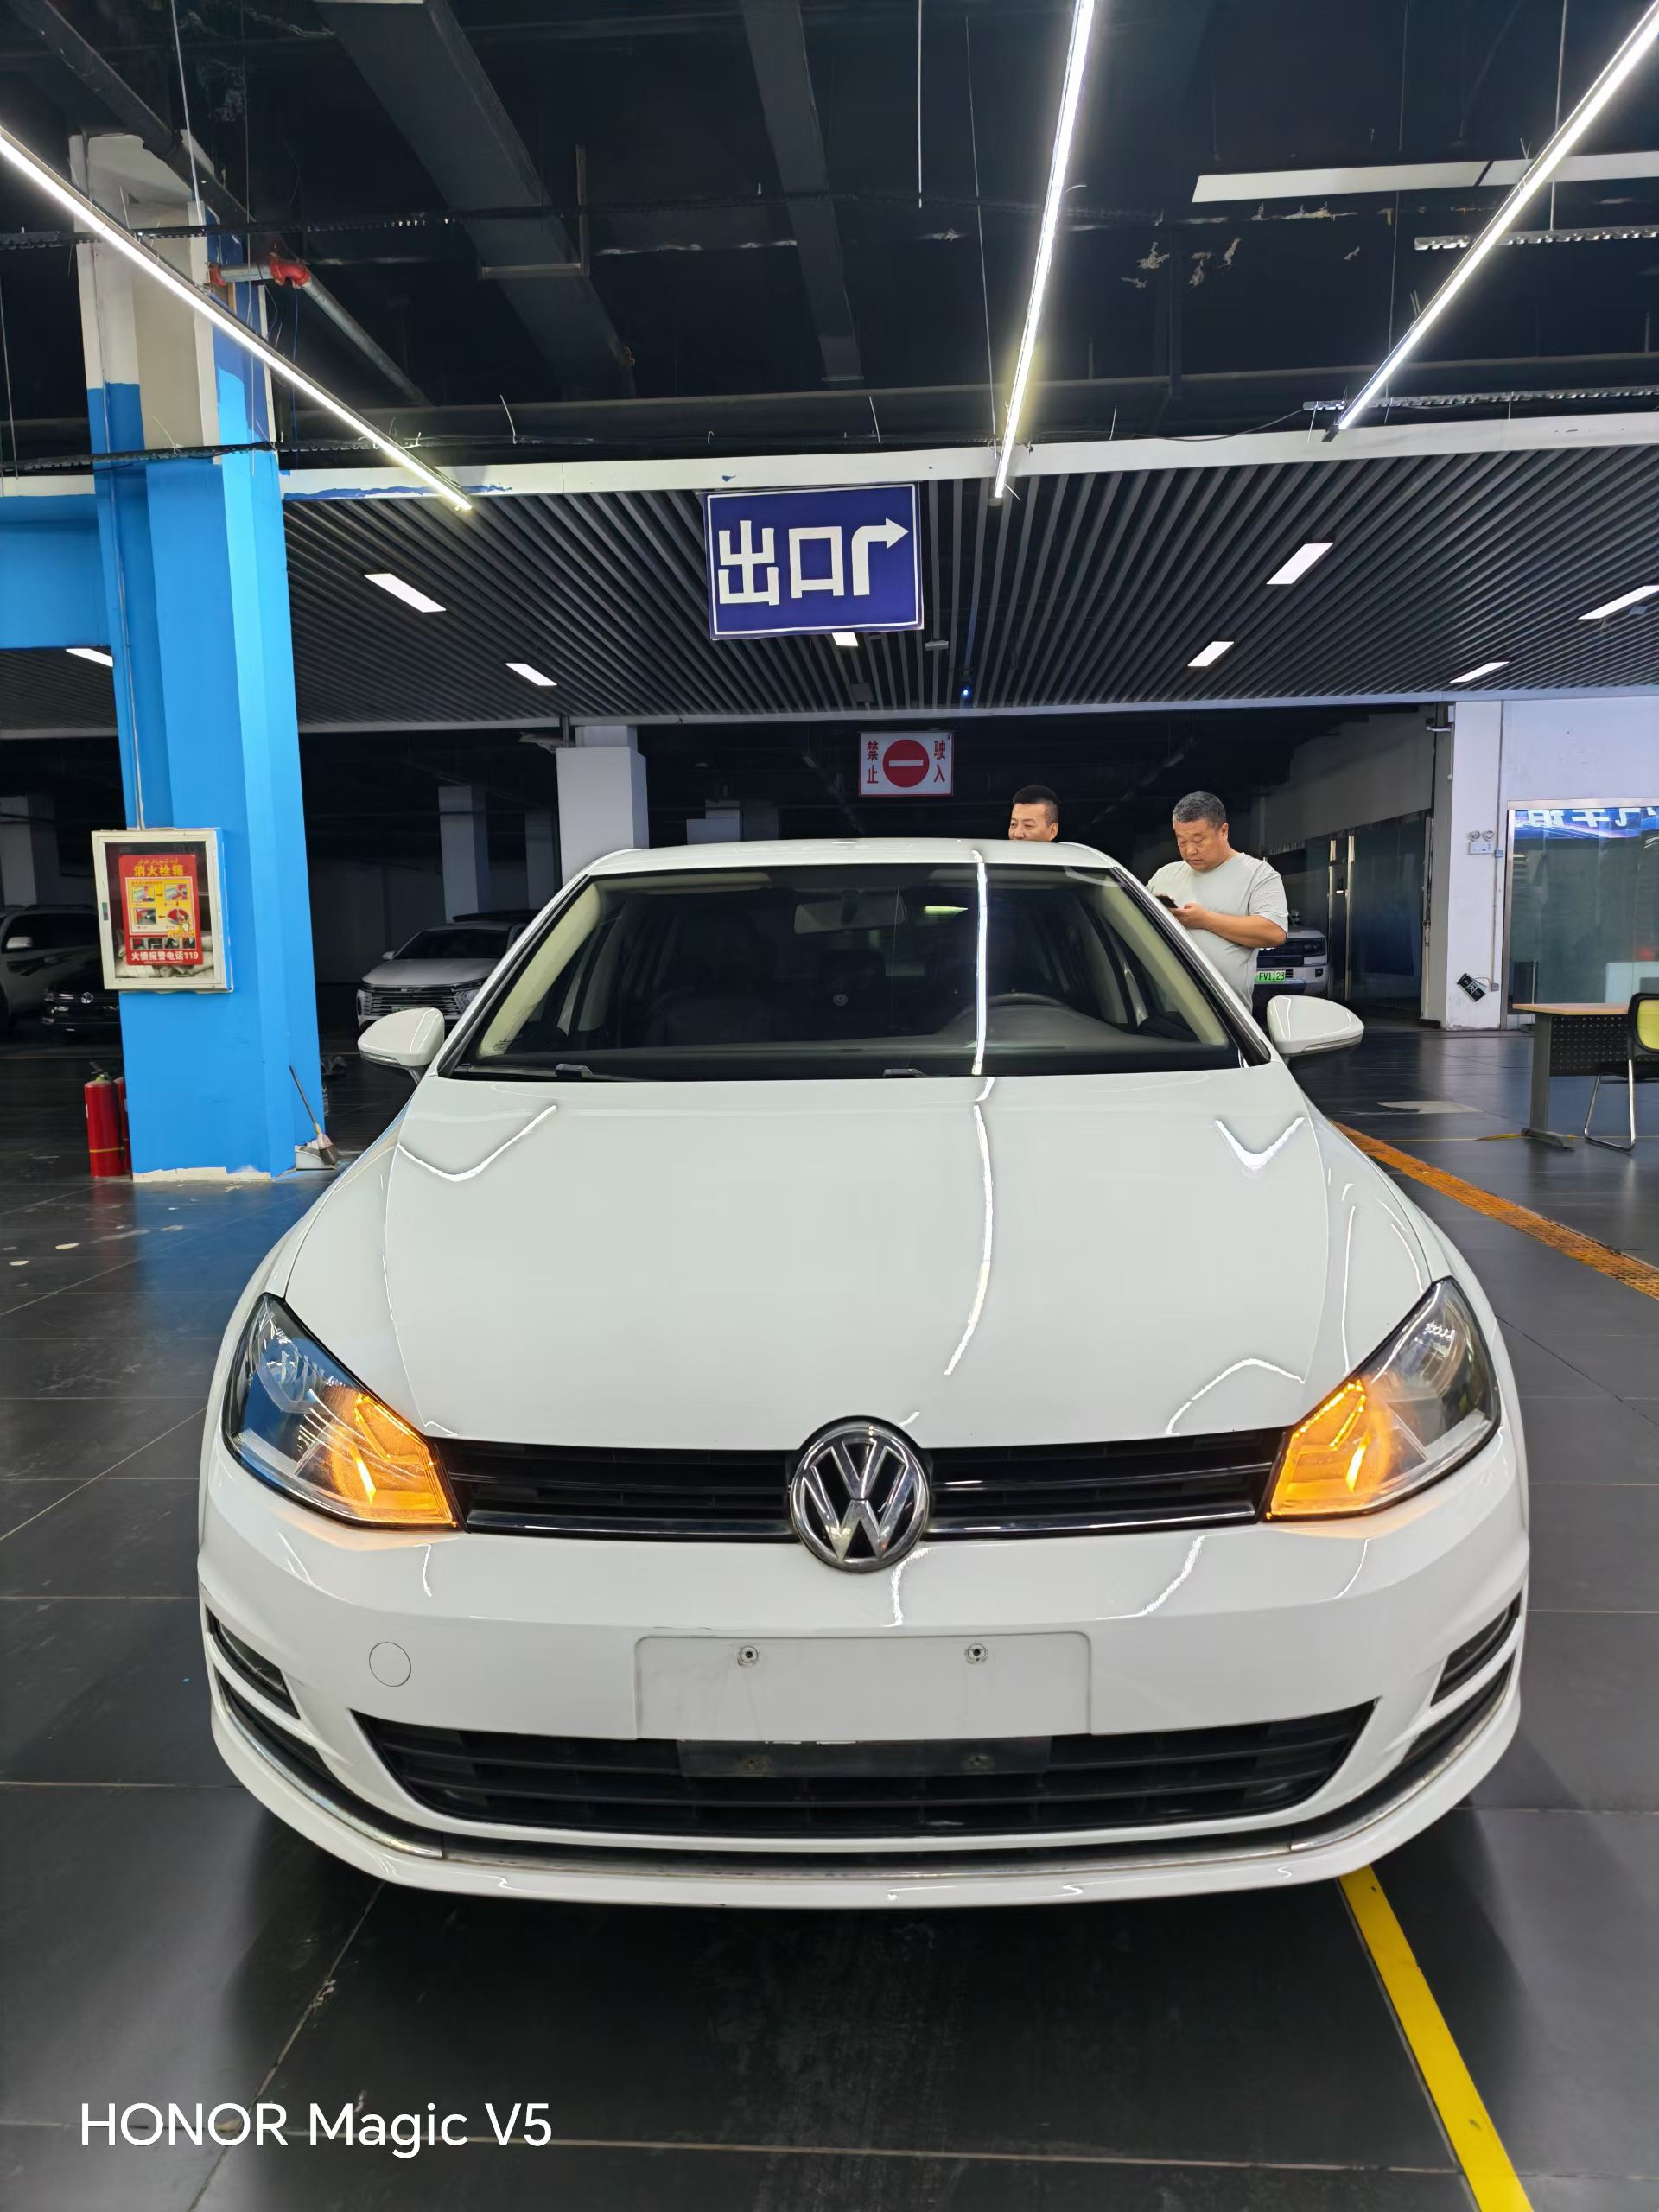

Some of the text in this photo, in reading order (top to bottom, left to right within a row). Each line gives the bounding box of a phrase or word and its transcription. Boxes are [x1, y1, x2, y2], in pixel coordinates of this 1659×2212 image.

[718, 520, 844, 605] 出口
[867, 741, 879, 784] 禁止
[934, 740, 946, 783] 驶入
